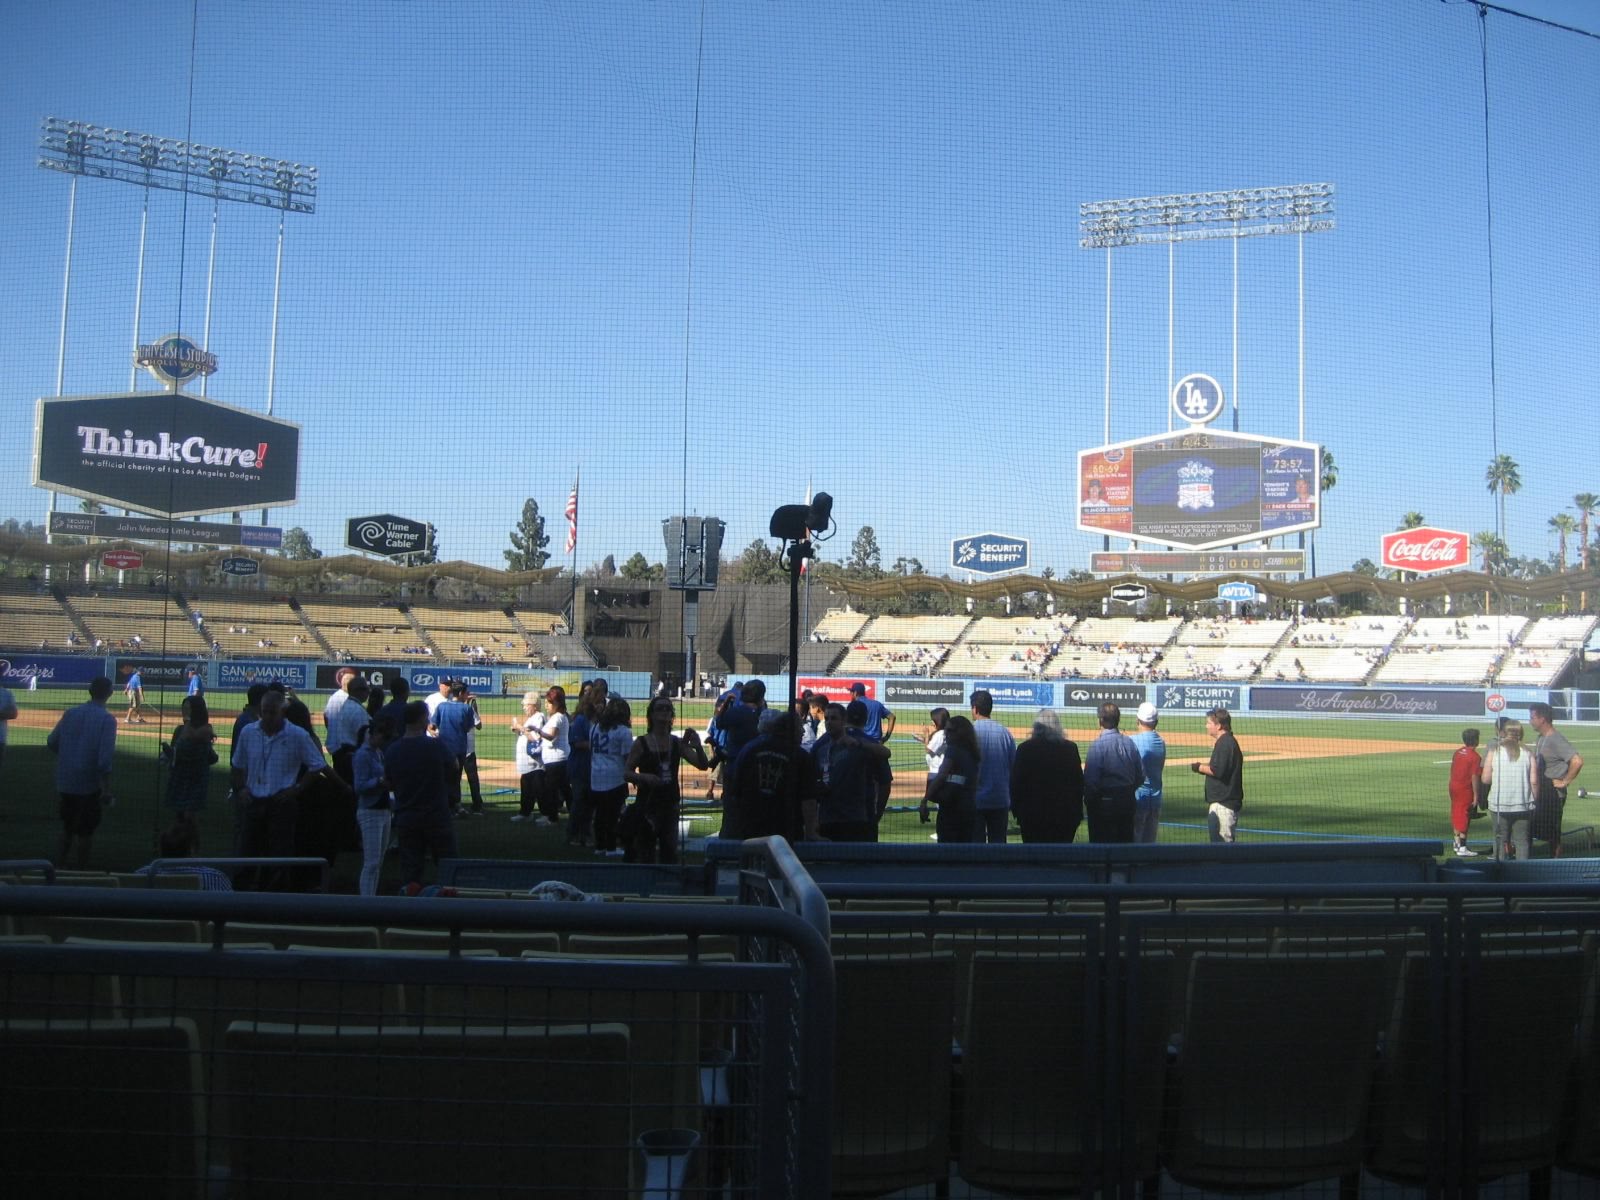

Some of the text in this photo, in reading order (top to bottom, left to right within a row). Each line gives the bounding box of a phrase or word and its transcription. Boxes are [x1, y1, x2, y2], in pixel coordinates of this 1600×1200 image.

[1184, 382, 1208, 414] LA
[78, 426, 268, 468] ThinkCure!
[97, 460, 125, 469] official
[128, 463, 156, 473] charity
[158, 465, 166, 473] of
[182, 467, 194, 475] Los
[197, 469, 226, 479] Angeles
[229, 471, 260, 481] Dodgers
[387, 522, 409, 532] Time
[386, 531, 419, 540] Warner
[386, 539, 411, 548] Cable
[980, 543, 1024, 553] SECURITY
[1388, 538, 1461, 562] Coca-Cola
[980, 552, 1016, 562] BENEFIT
[1222, 587, 1251, 597] AVITA
[221, 665, 304, 678] SAN MANUEL
[438, 674, 491, 686] NDAI
[826, 686, 851, 694] Americ
[896, 687, 961, 696] Time Warner Cable
[1013, 688, 1033, 697] Lynch
[1184, 687, 1234, 698] SECURITY
[1092, 692, 1140, 700] INFINITI
[1184, 698, 1227, 708] BENEFIT
[1296, 690, 1438, 714] Los Angeles Dodgers
